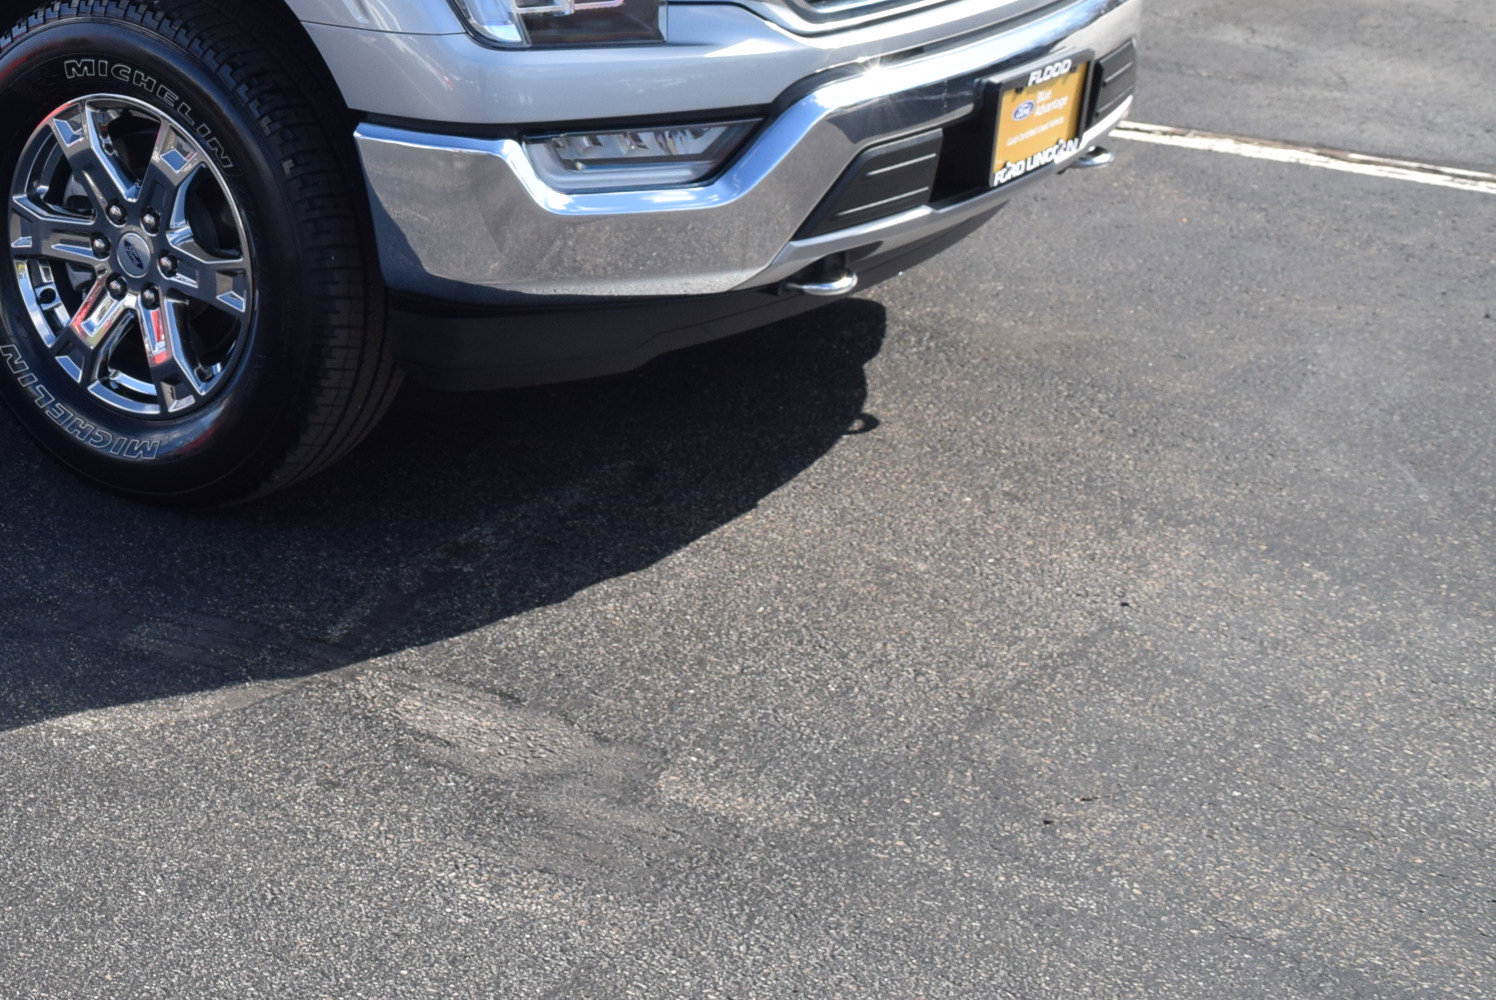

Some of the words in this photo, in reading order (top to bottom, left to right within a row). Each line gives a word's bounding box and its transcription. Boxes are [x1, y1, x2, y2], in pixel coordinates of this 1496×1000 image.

[1028, 59, 1072, 87] FLOOD
[64, 59, 233, 168] MICHELIN
[994, 161, 1025, 187] FORD
[0, 344, 160, 459] MICHELIN
